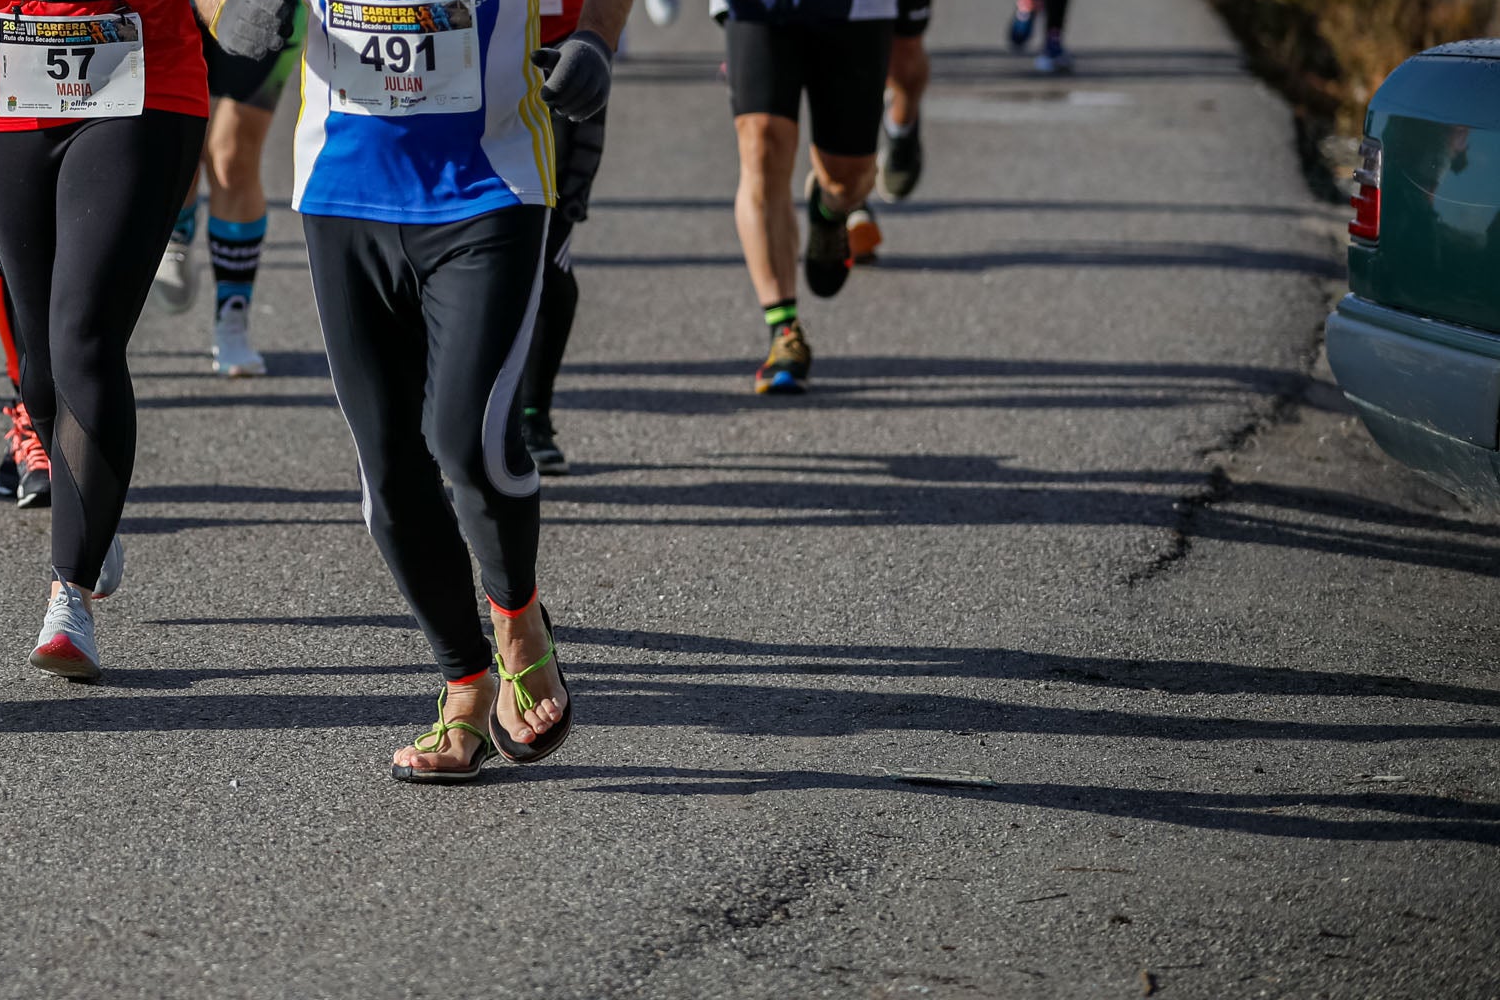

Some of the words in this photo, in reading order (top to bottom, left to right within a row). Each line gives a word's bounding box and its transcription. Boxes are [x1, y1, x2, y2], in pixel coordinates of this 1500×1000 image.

[332, 2, 344, 13] 26
[352, 4, 362, 21] VII
[362, 6, 415, 16] CARRERA
[363, 15, 416, 23] POPULAR
[3, 21, 15, 30] 26
[25, 23, 36, 36] VII
[36, 22, 87, 30] CARRERA
[362, 22, 391, 30] Secaderos
[360, 35, 436, 73] 491
[47, 48, 96, 80] 57
[56, 83, 92, 96] MARIA
